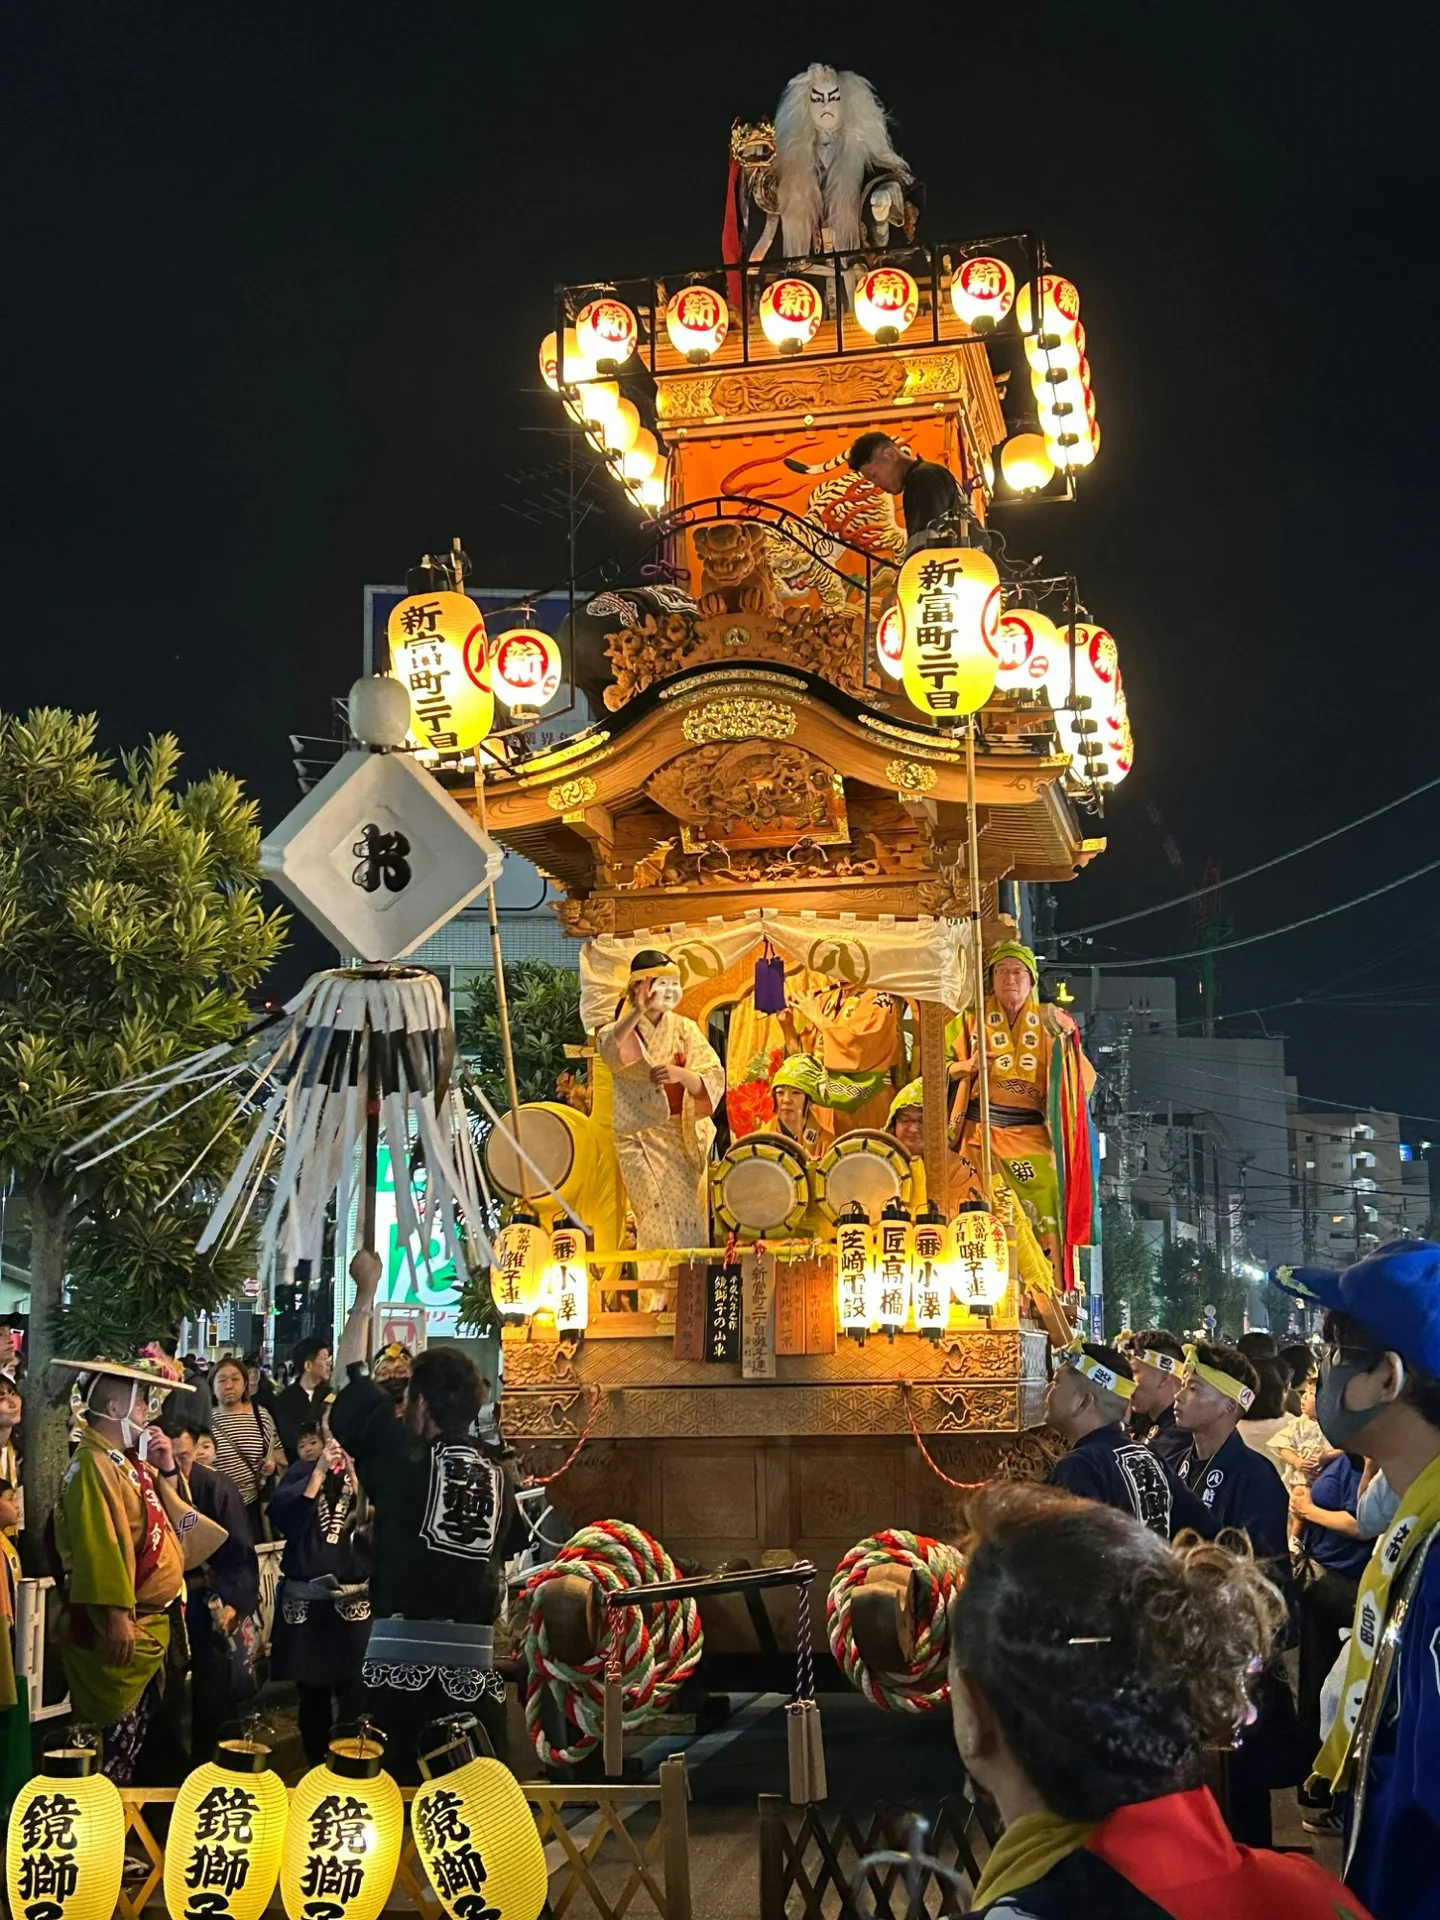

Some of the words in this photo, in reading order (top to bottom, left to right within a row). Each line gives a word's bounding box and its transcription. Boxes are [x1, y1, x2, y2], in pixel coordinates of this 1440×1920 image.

[870, 271, 909, 308] 新
[967, 261, 1003, 297] 新
[680, 291, 717, 328] 新
[777, 284, 812, 320] 新
[595, 304, 629, 339] 新
[917, 558, 963, 710] 新富町二丁目
[400, 601, 459, 749] 新富町二丁目
[504, 640, 544, 683] 新
[917, 1260, 941, 1320] 小澤
